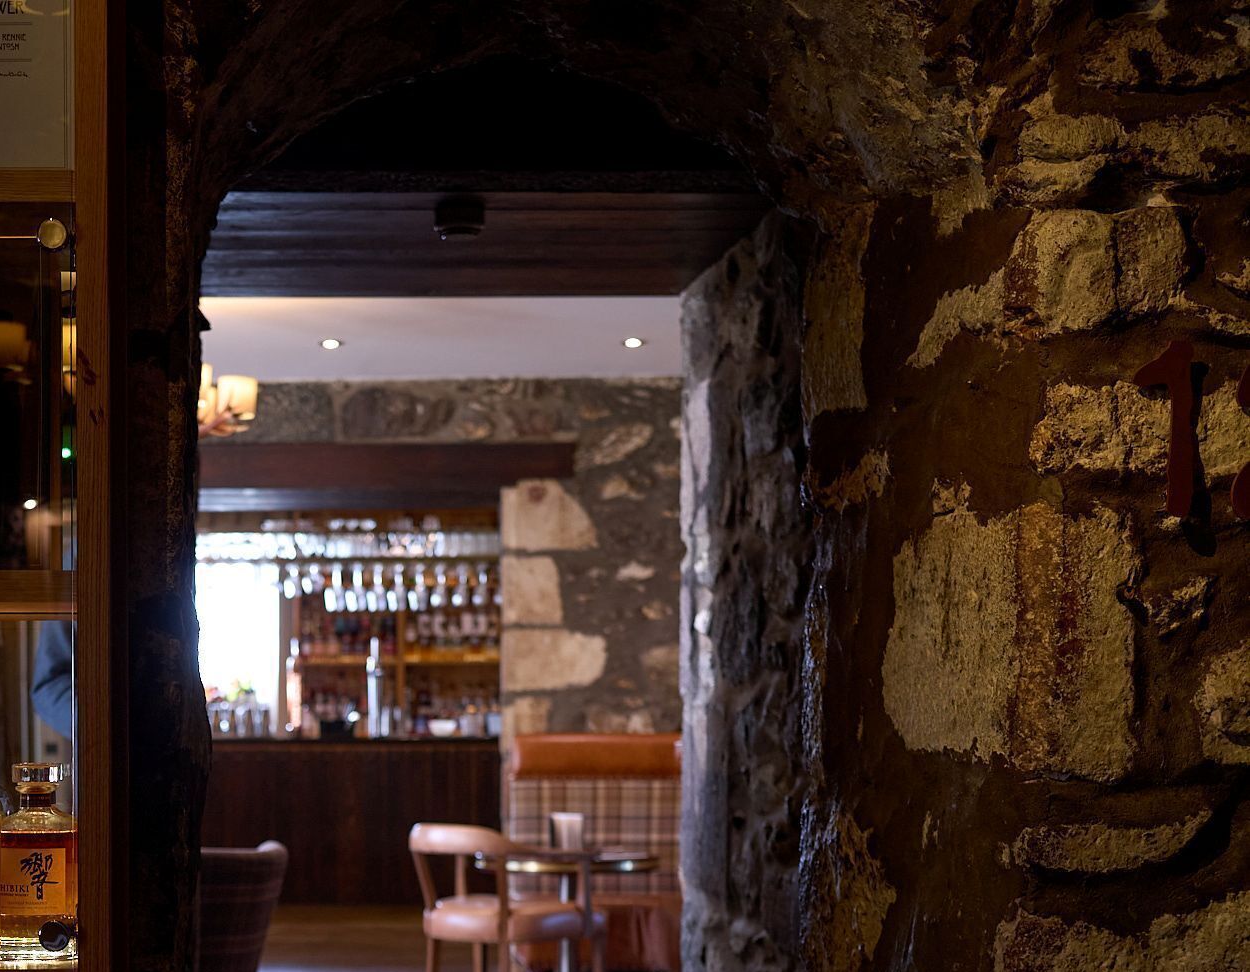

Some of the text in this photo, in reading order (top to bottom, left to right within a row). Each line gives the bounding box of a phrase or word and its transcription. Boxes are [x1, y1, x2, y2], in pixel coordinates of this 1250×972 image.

[1, 34, 26, 42] RENNIE
[19, 852, 60, 900] 響
[0, 885, 29, 893] HIBIKI
